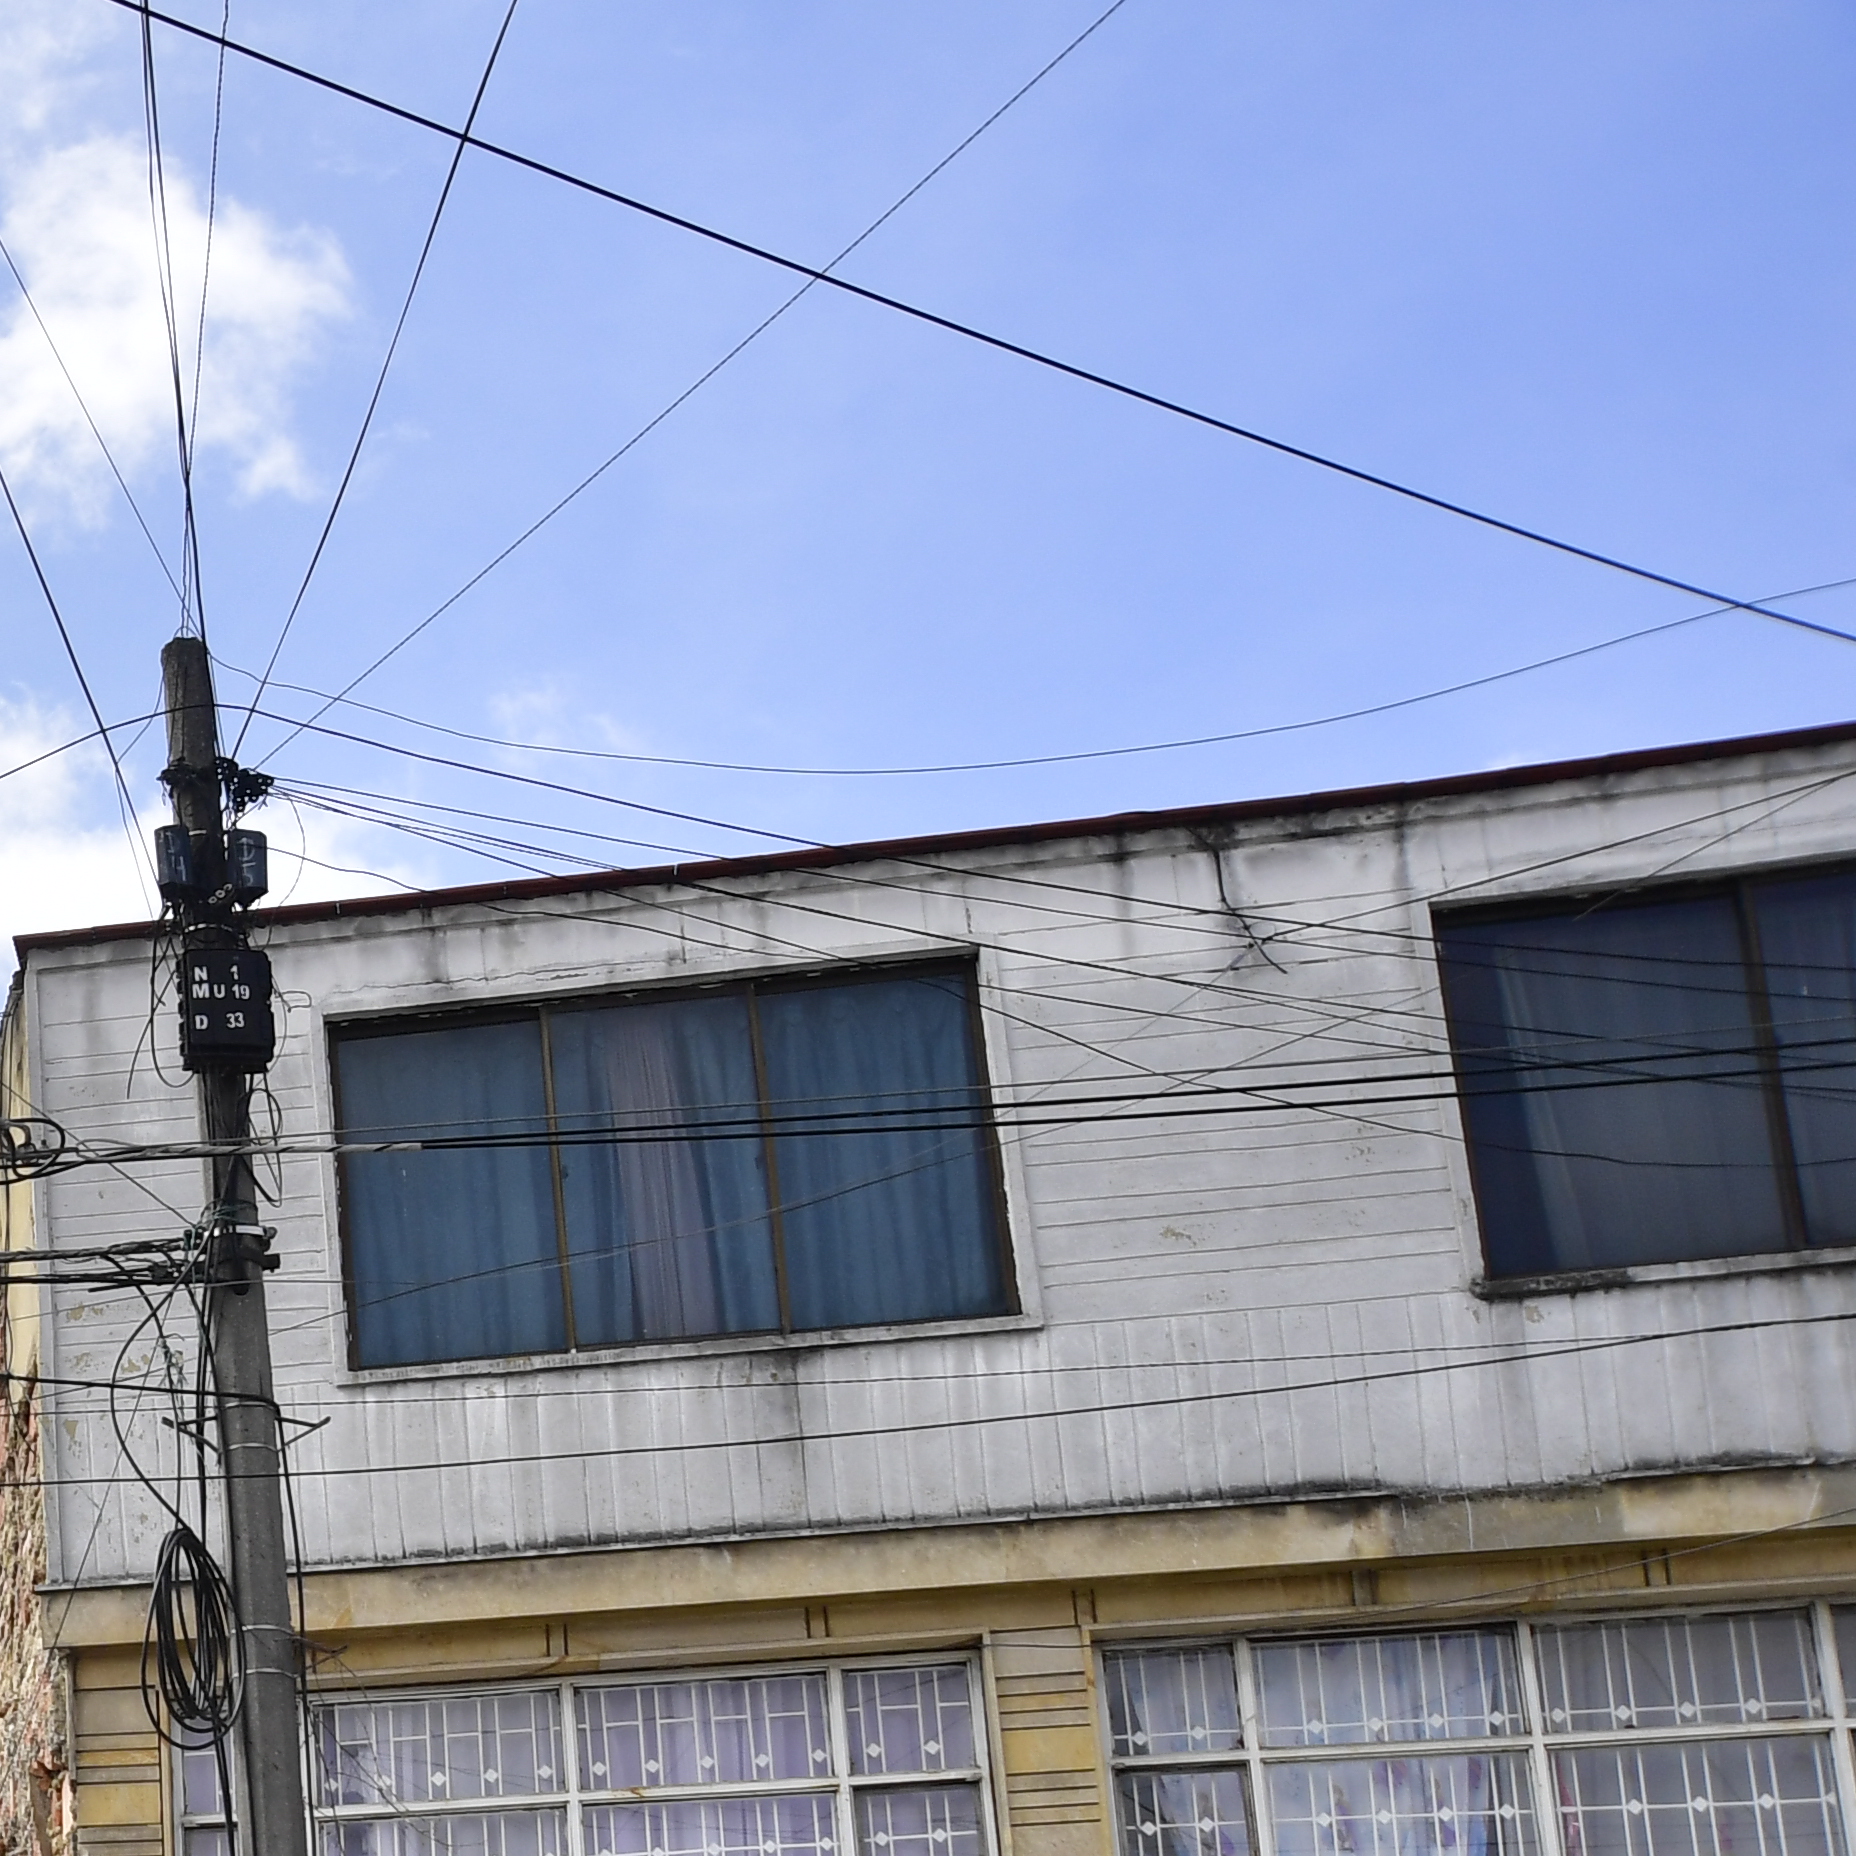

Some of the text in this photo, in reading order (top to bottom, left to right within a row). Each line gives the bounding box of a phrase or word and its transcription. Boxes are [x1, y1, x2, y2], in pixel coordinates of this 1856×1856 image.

[193, 964, 239, 982] N 1
[231, 983, 251, 1000] 19
[194, 1011, 245, 1030] D 33
